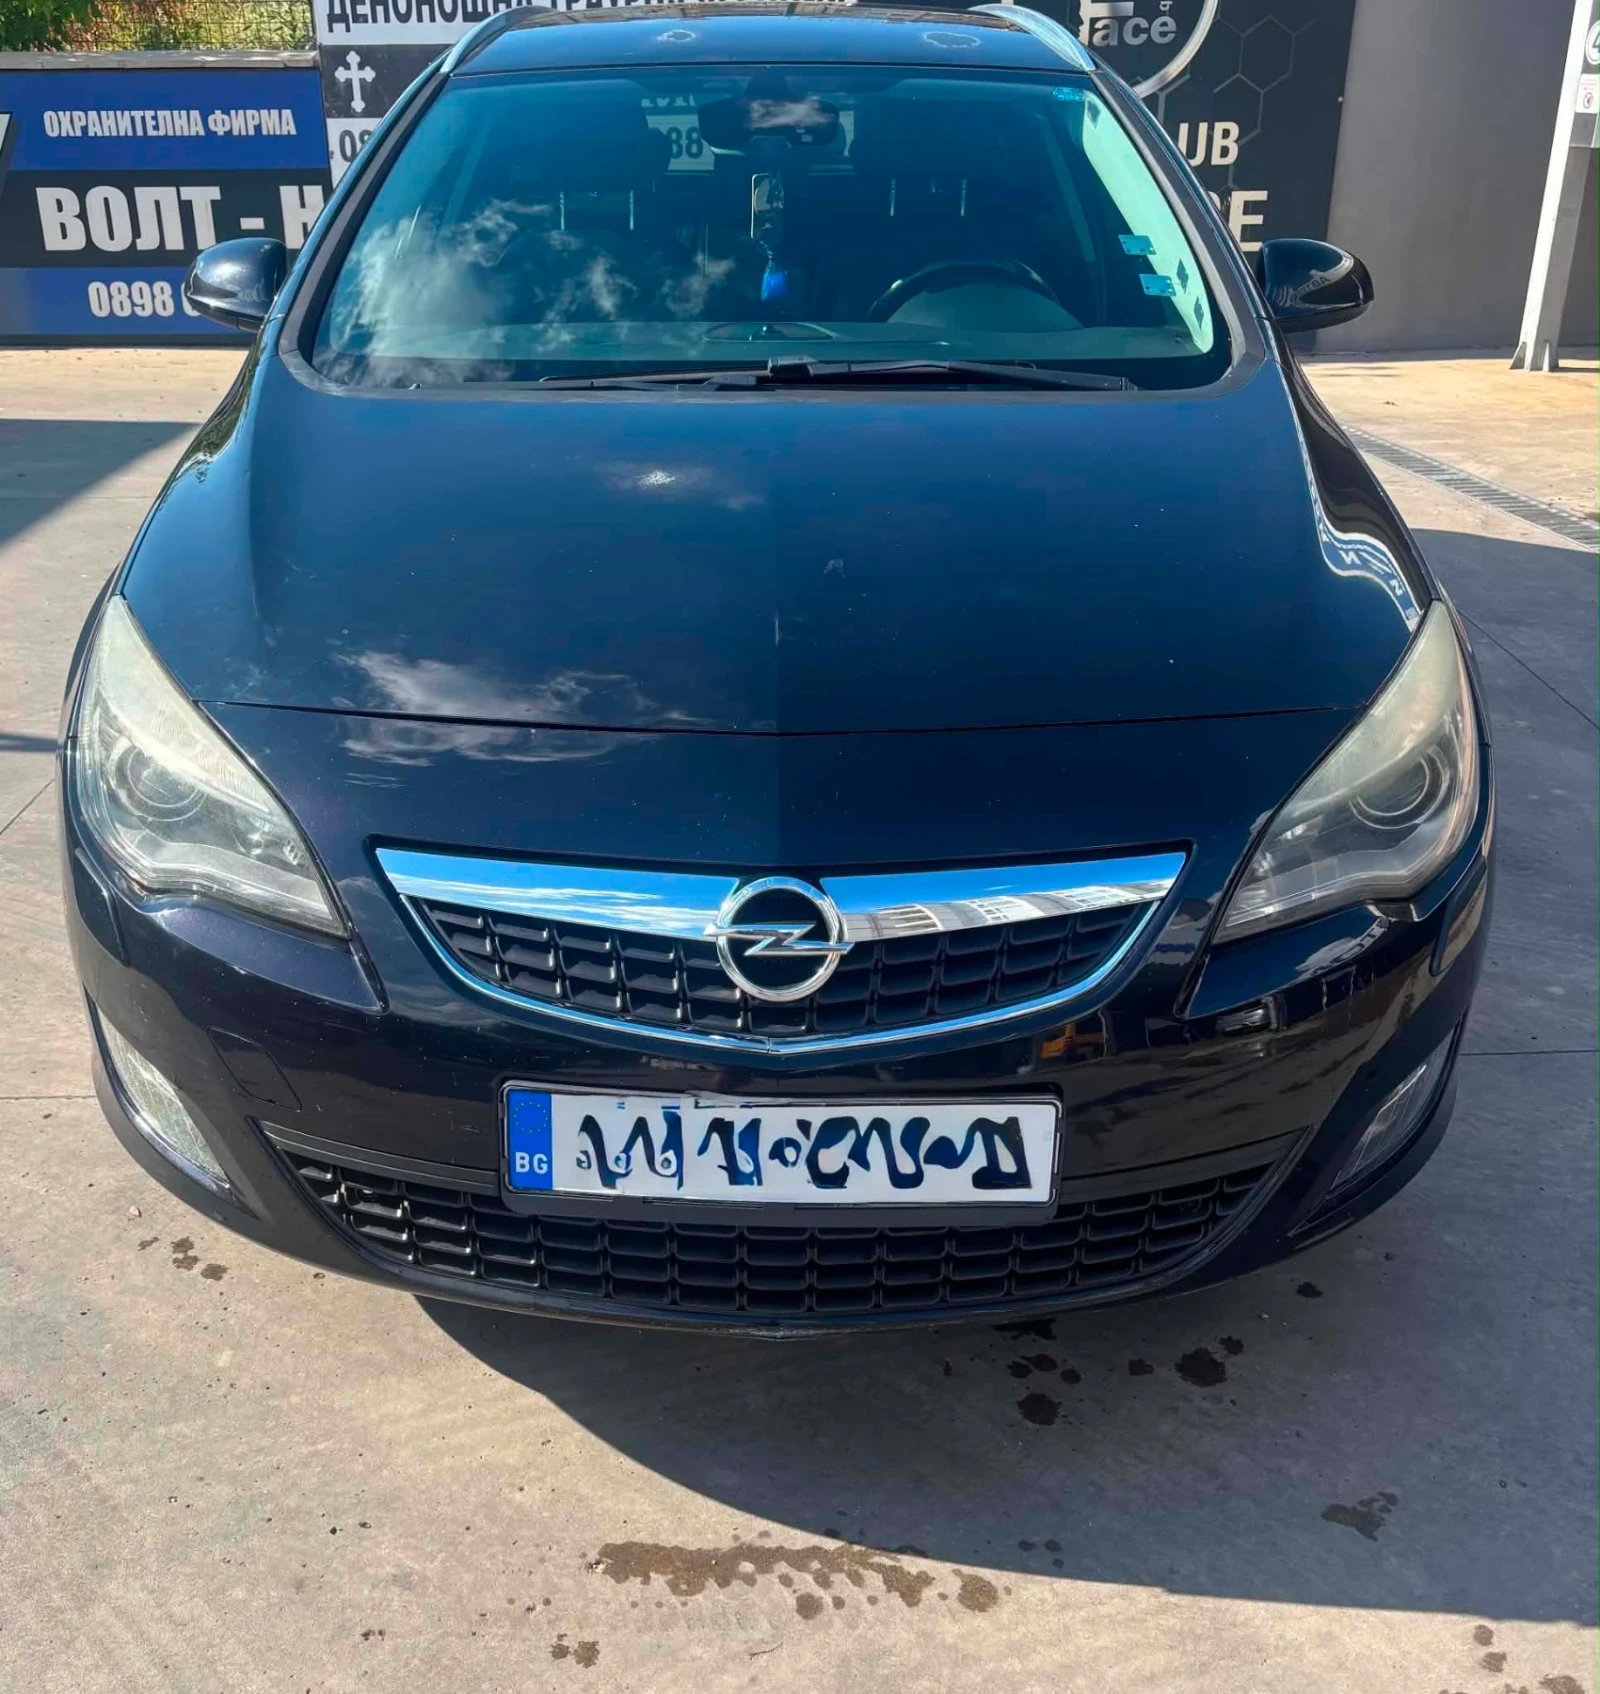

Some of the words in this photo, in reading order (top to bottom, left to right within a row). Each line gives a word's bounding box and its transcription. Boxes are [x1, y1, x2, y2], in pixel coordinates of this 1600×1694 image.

[43, 110, 205, 137] ОХРАНИТЕЛНА
[208, 108, 297, 137] ФИРМА
[35, 186, 221, 251] ВОЛТ
[87, 281, 174, 317] 0898
[515, 1153, 549, 1174] BG
